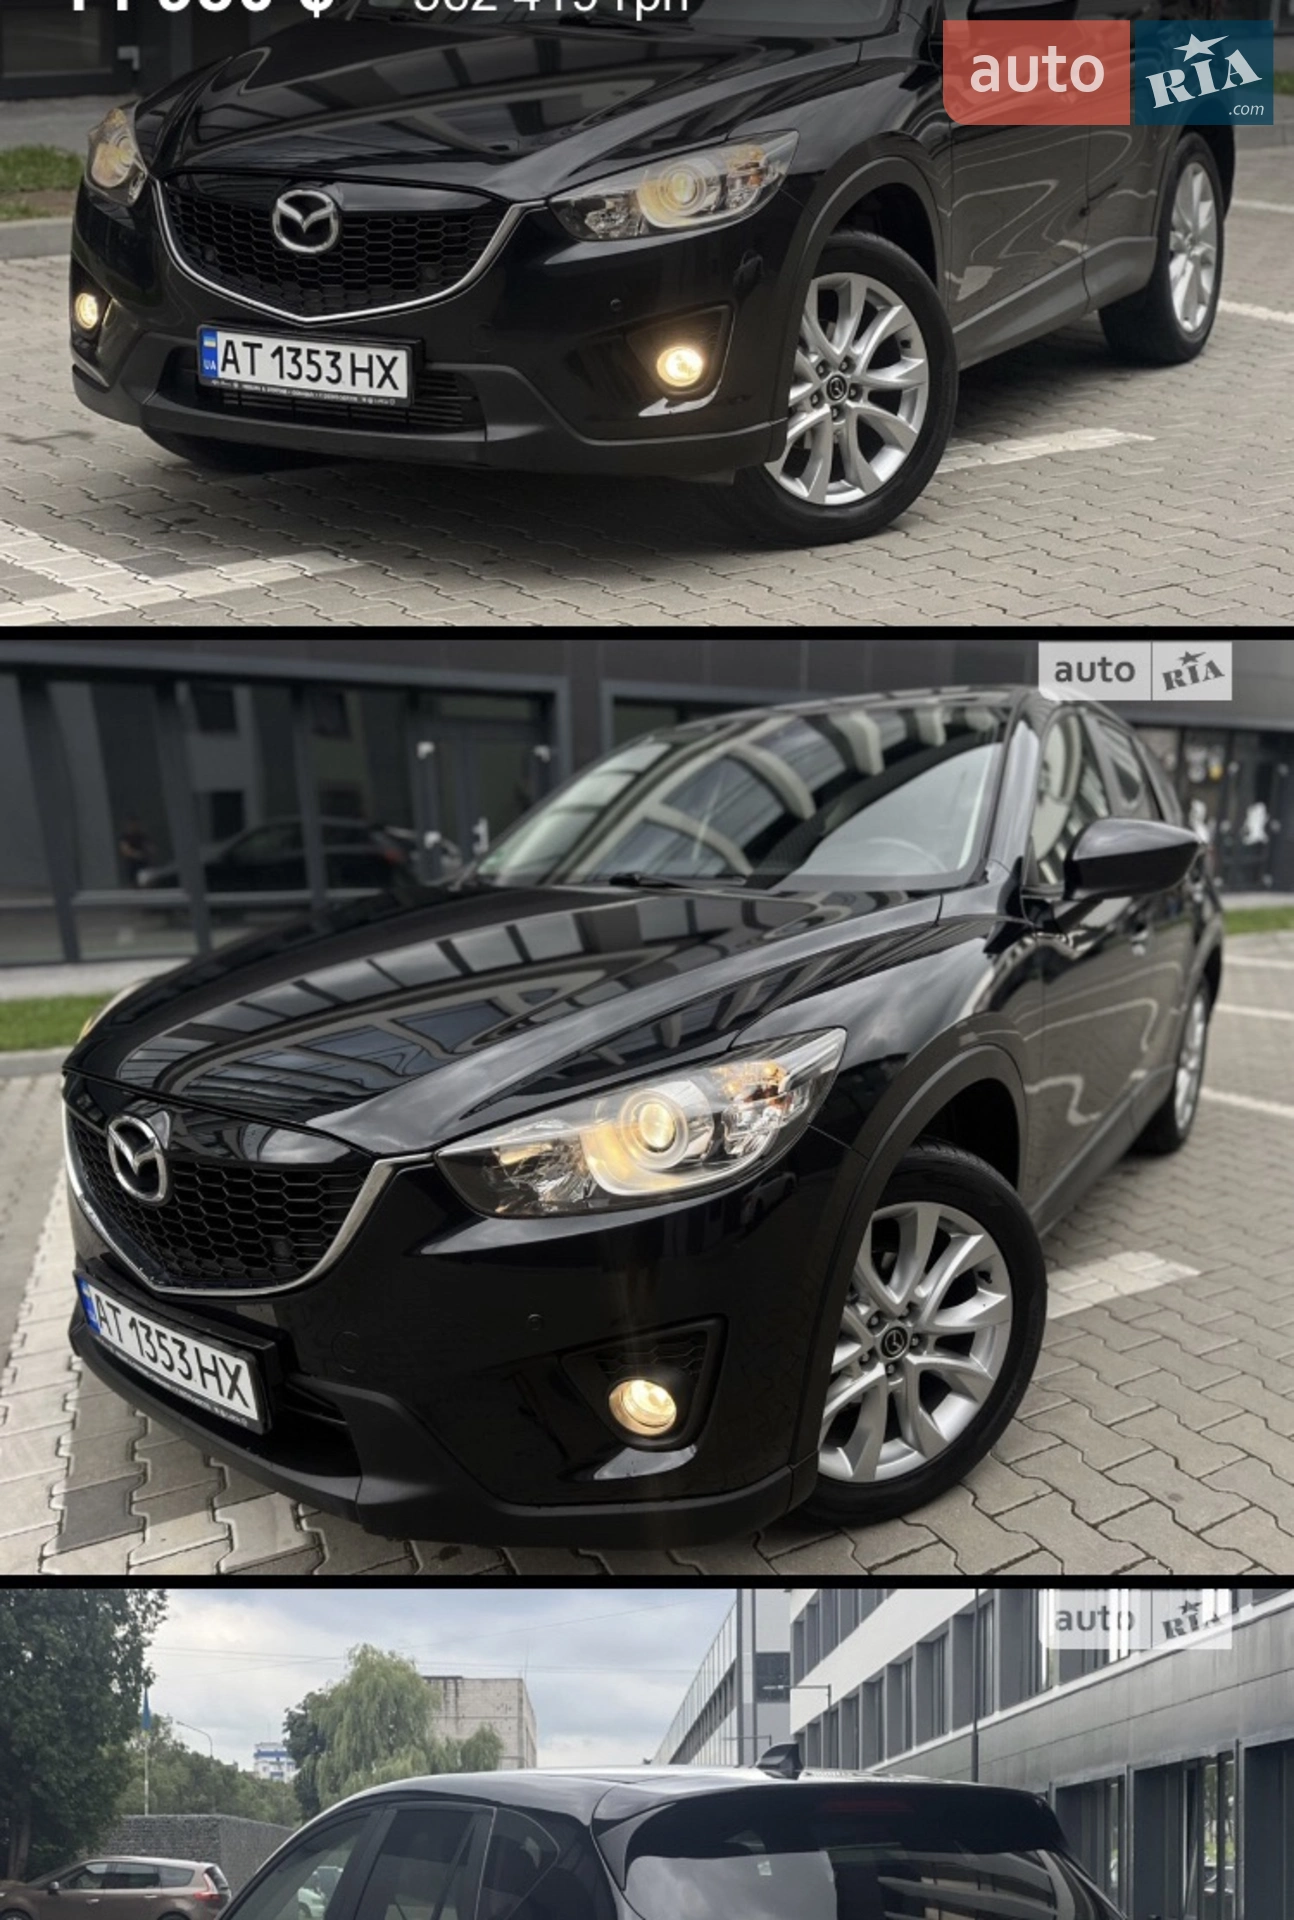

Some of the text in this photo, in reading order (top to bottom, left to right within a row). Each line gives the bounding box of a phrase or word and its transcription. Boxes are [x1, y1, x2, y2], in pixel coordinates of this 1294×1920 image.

[203, 359, 217, 370] UA
[220, 339, 399, 390] AT 1353 HX
[95, 1293, 124, 1344] AT
[128, 1316, 193, 1381] 1353
[194, 1347, 250, 1408] HX
